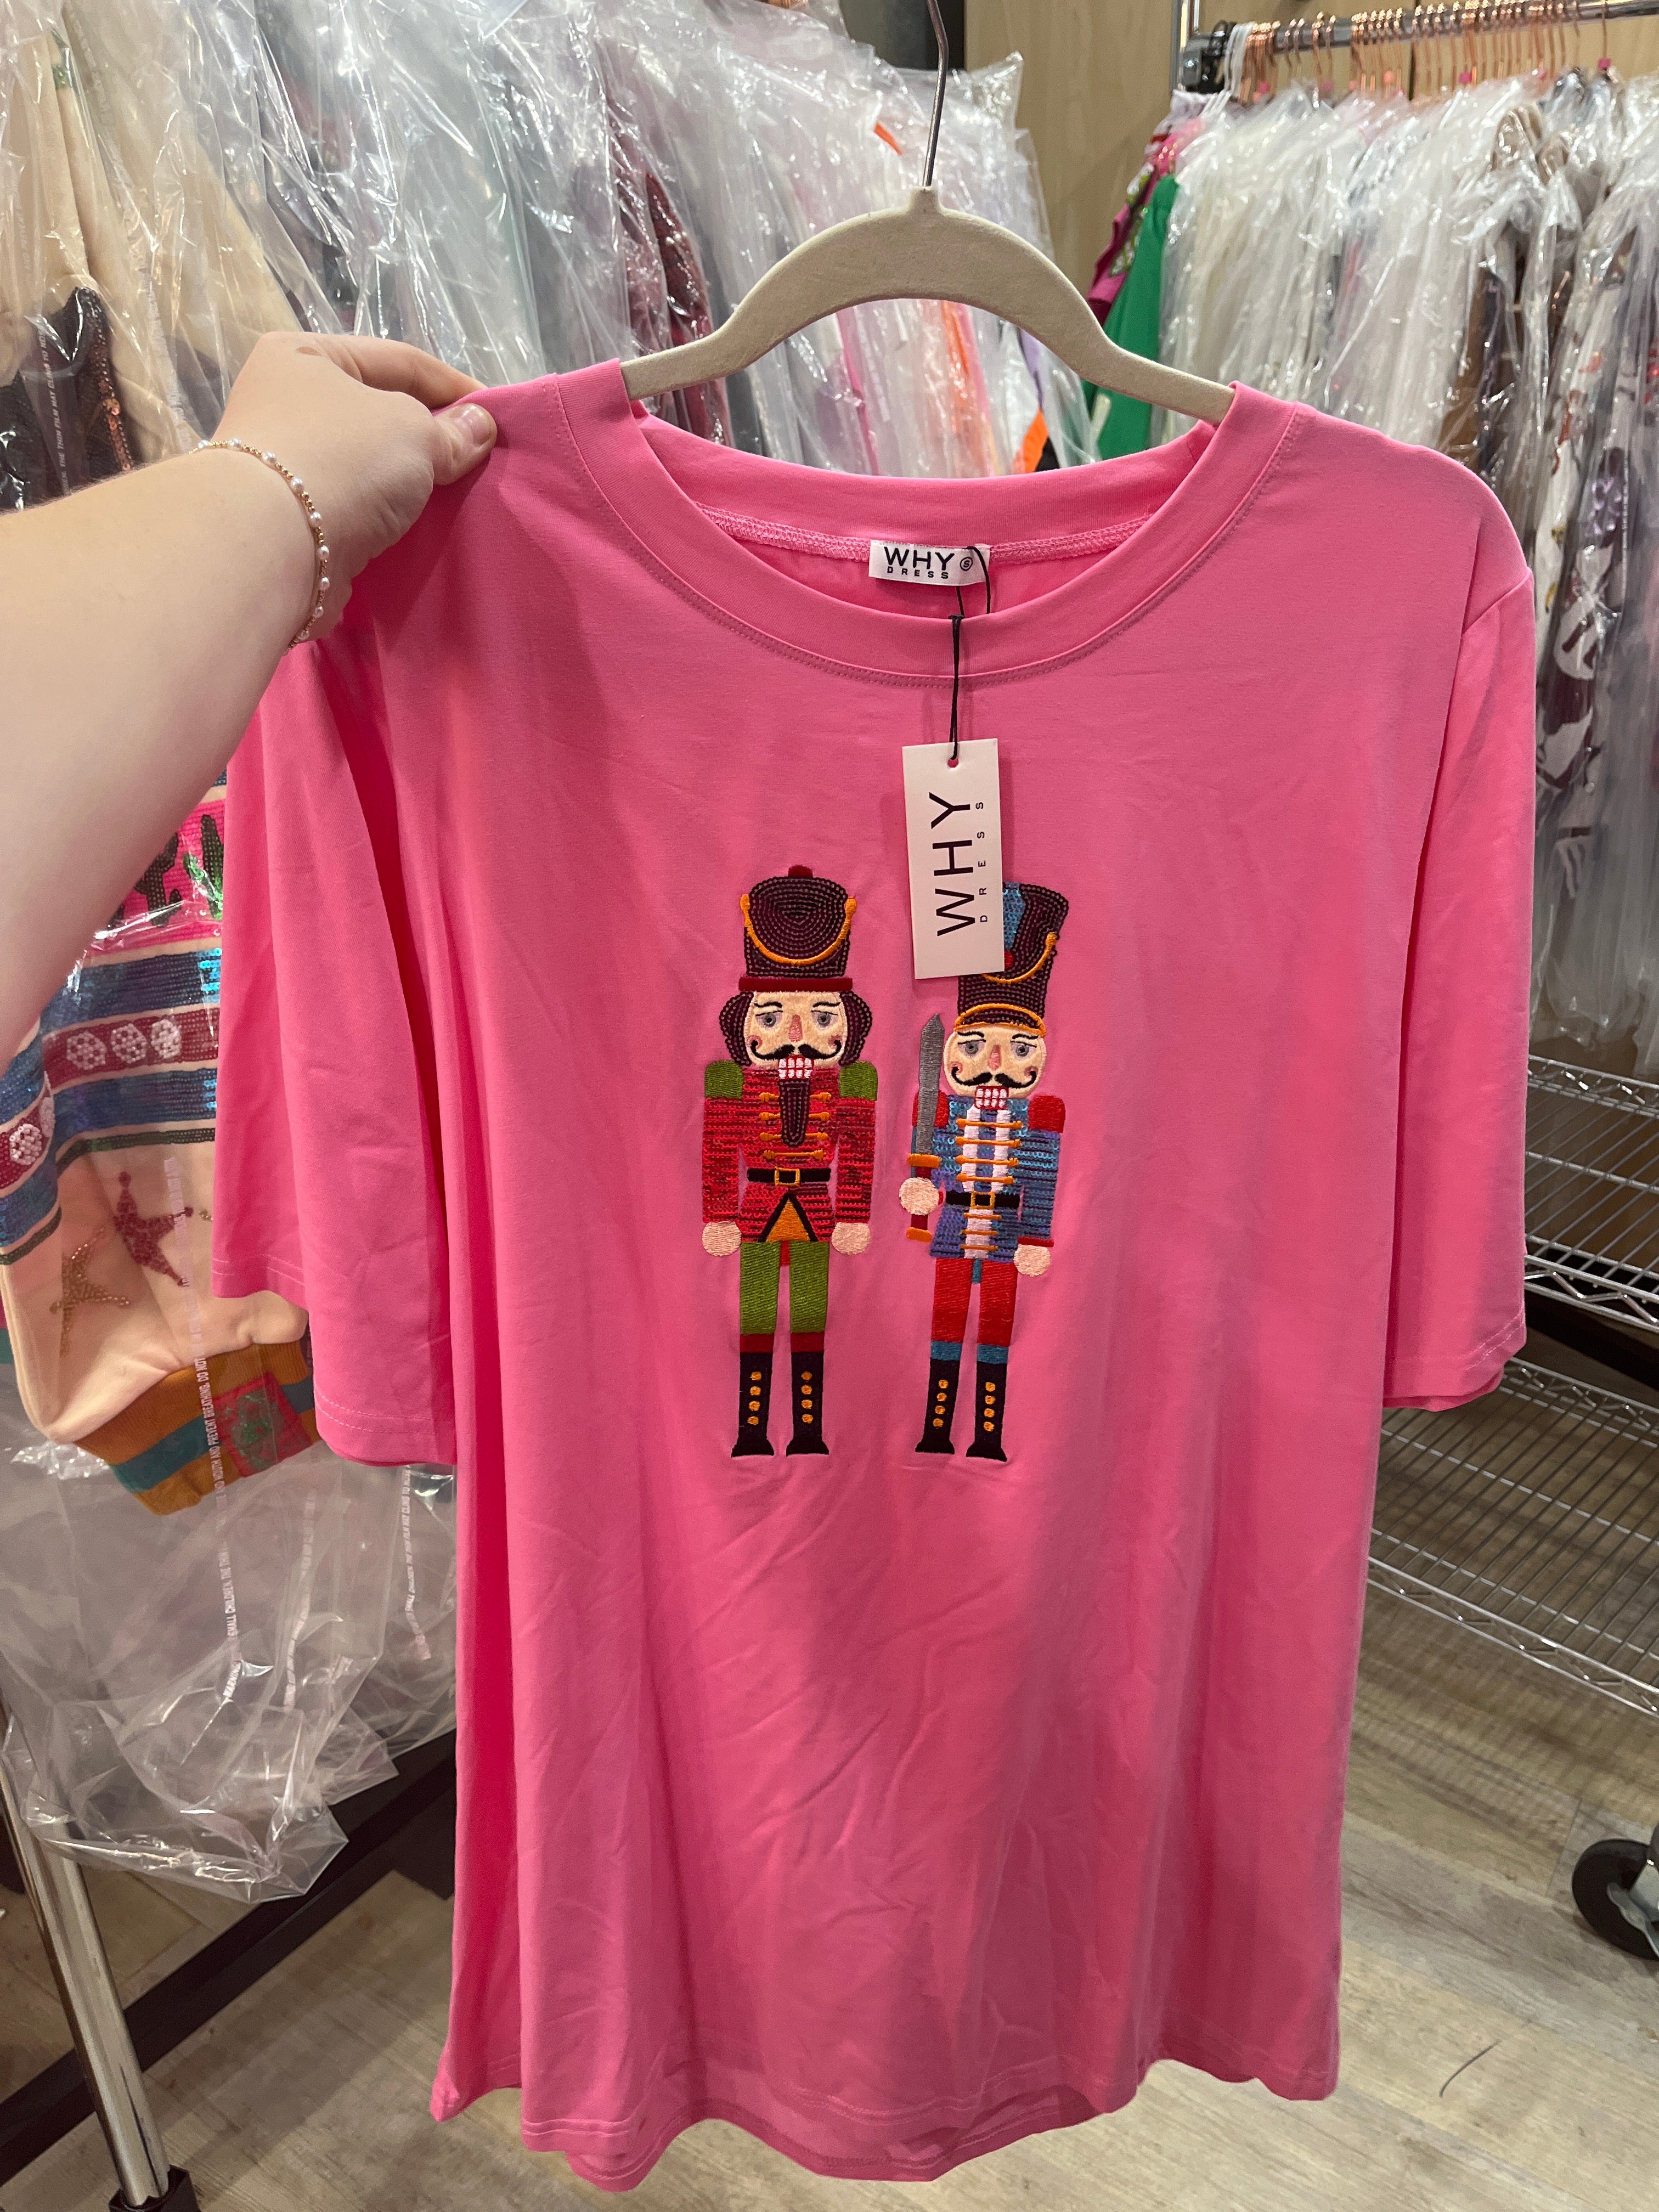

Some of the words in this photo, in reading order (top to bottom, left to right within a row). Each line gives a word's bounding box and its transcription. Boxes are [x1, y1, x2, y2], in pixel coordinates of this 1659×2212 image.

[884, 546, 955, 571] WHY
[887, 566, 949, 579] DRESS
[928, 792, 975, 936] WHY
[975, 801, 988, 923] DRESS
[194, 1358, 207, 1371] NOT
[196, 1371, 208, 1381] DO
[205, 1418, 219, 1446] PREVENT
